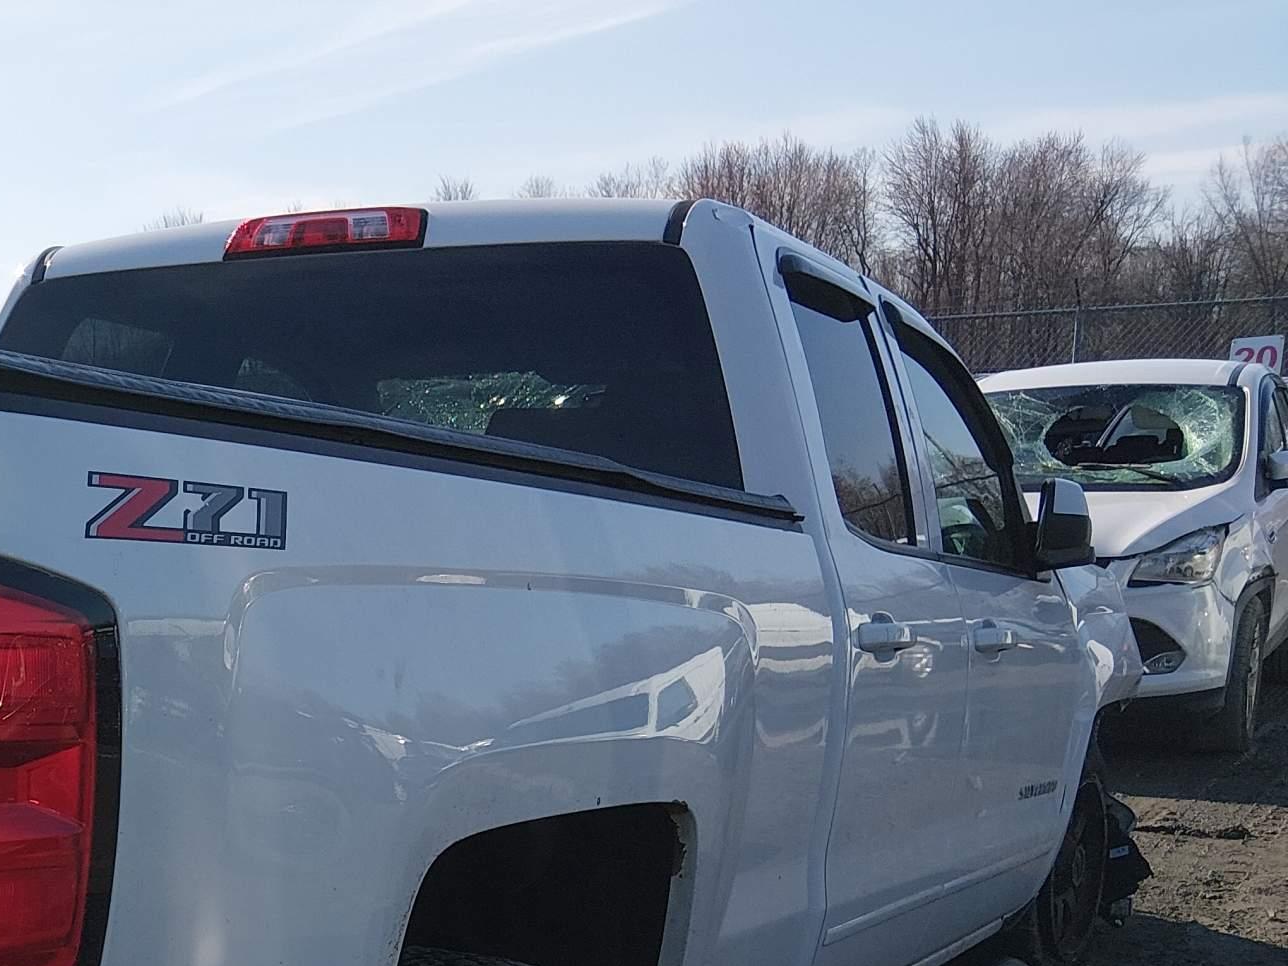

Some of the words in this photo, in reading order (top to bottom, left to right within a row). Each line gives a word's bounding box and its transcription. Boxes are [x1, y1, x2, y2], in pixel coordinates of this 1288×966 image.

[85, 471, 288, 550] Z71
[186, 532, 226, 545] OFF
[230, 535, 282, 548] ROAD
